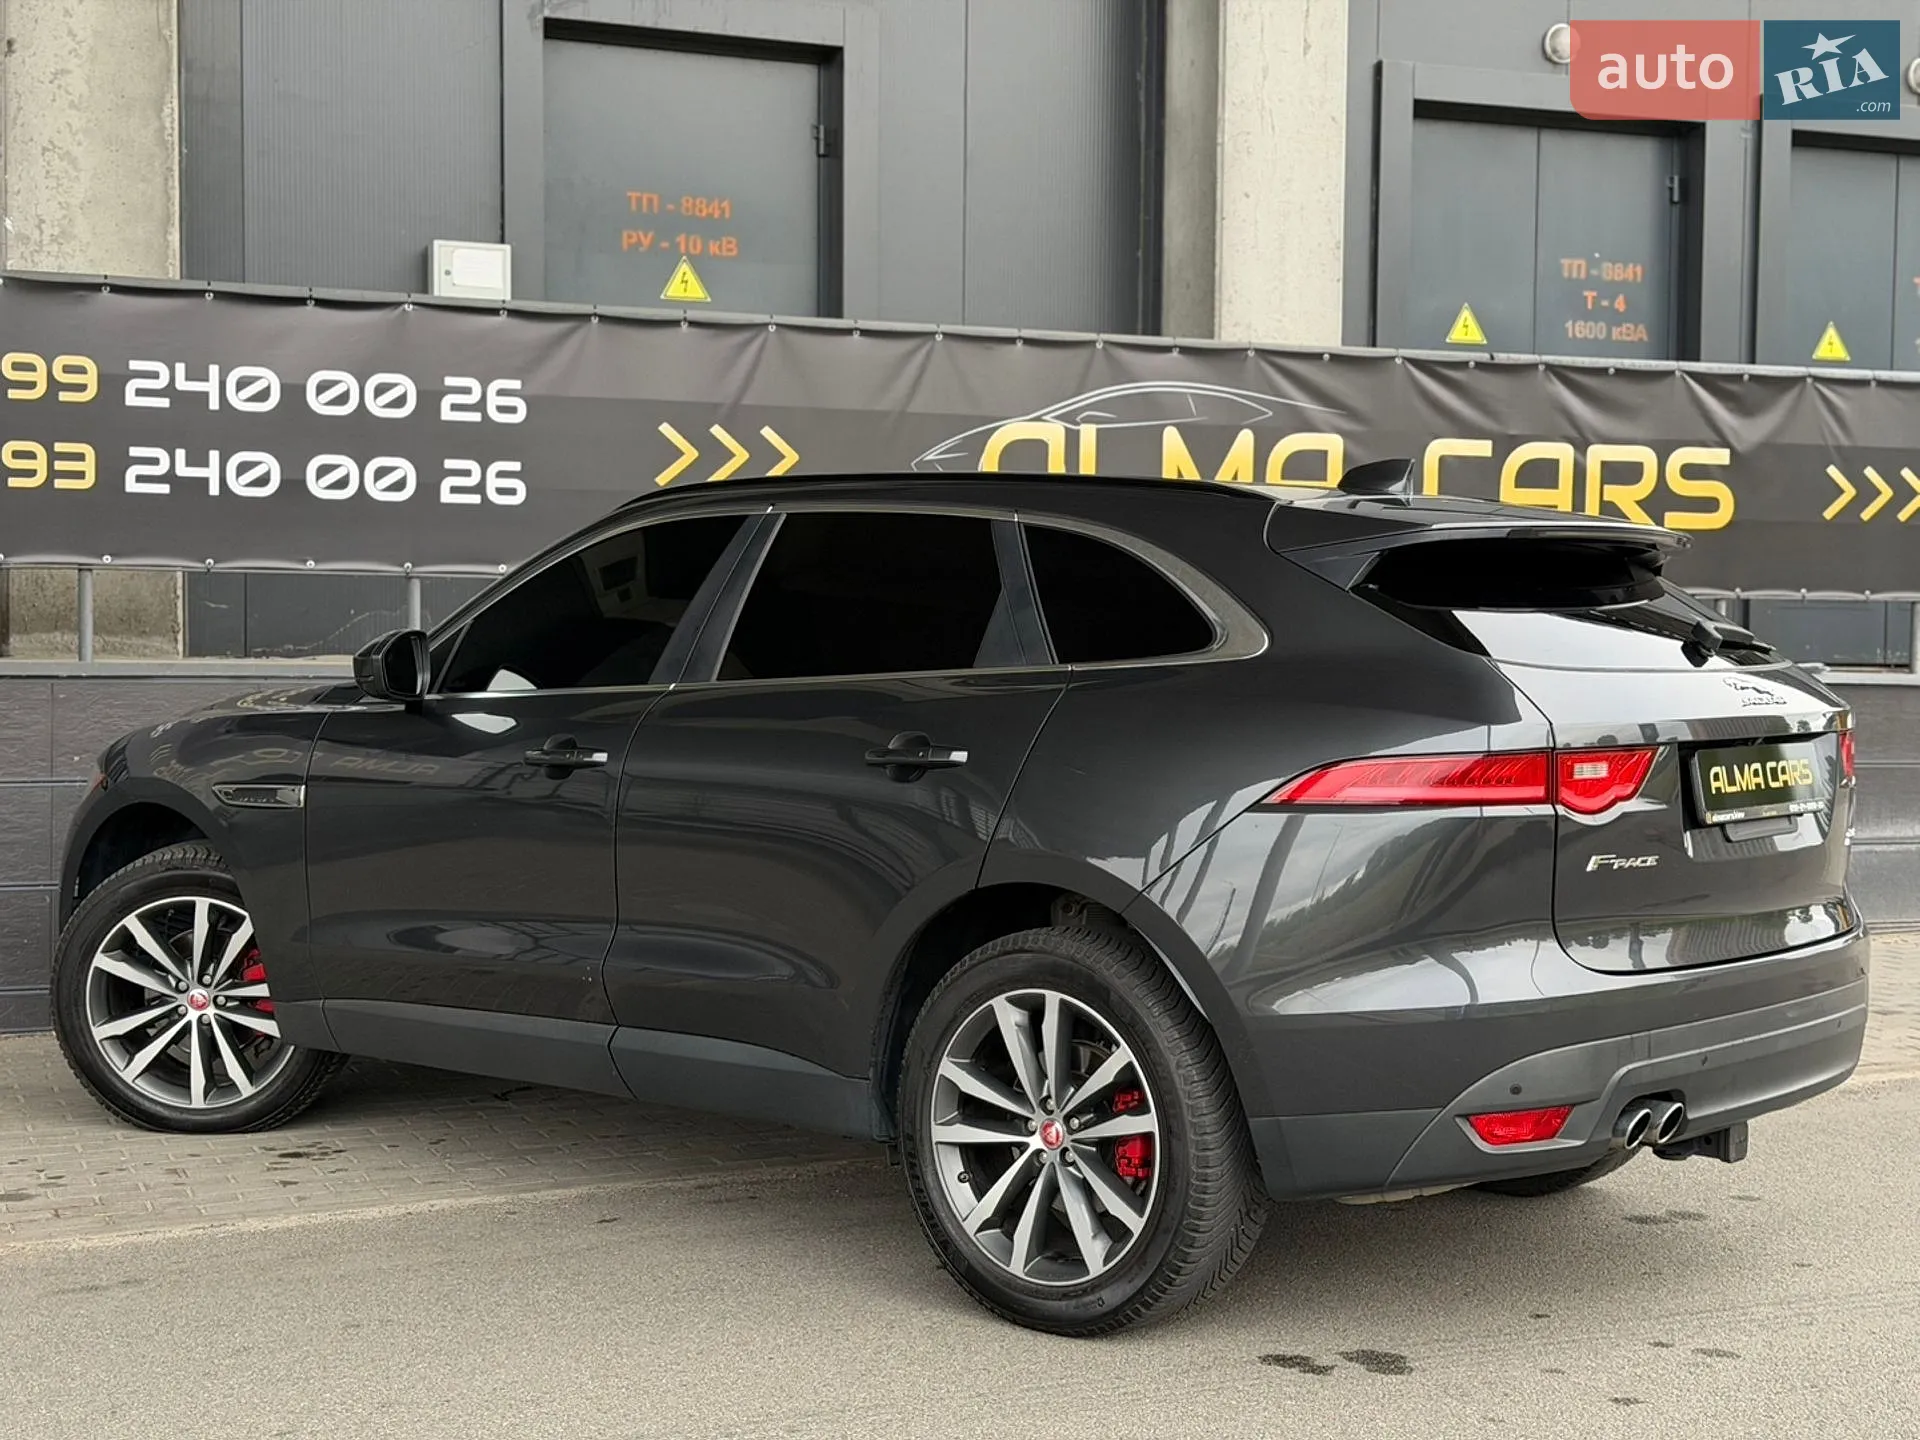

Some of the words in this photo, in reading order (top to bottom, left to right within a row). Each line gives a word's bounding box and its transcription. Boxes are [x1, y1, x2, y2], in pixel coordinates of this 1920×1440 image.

[627, 191, 660, 214] ТП
[680, 195, 732, 220] 8841
[621, 230, 655, 252] РУ
[675, 233, 703, 255] 10
[1613, 293, 1627, 313] 4
[1564, 320, 1607, 340] 1600
[1, 352, 98, 403] 99
[125, 359, 281, 413] 240
[306, 370, 417, 418] 00
[440, 376, 527, 424] 26
[1, 440, 96, 490] 93
[125, 446, 281, 498] 240
[306, 454, 417, 502] 00
[440, 459, 527, 506] 26
[1422, 438, 1735, 530] CARS
[1709, 762, 1766, 795] ALMA
[1766, 758, 1813, 789] CARS
